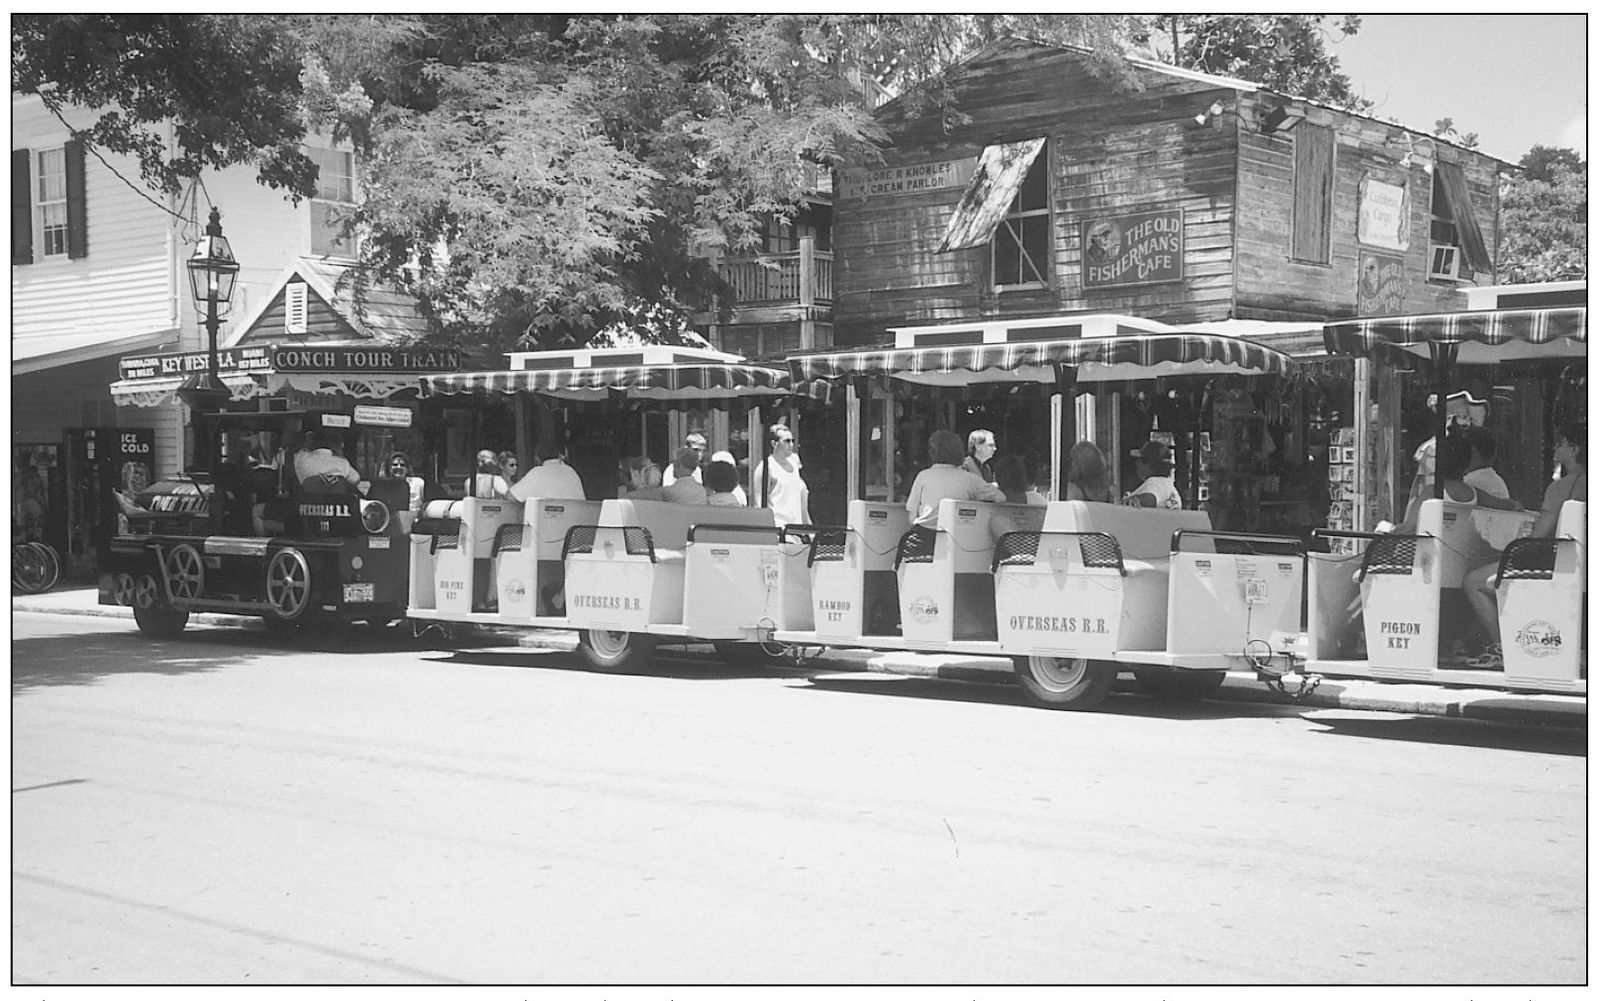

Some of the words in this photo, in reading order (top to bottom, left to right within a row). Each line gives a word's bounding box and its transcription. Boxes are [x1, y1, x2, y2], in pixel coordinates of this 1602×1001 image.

[905, 162, 951, 178] KNOWLES
[870, 181, 904, 195] CREAM
[906, 176, 944, 191] PARLOR
[1125, 219, 1153, 246] THE
[1154, 217, 1180, 233] OLD
[1088, 232, 1180, 281] FISHERMAN'S
[1138, 255, 1172, 279] CAFE
[161, 356, 183, 373] KEY
[184, 353, 210, 371] WEST
[216, 351, 237, 368] LA.
[250, 357, 270, 368] MILES
[275, 351, 336, 368] CONCH
[343, 351, 394, 368] TOUR
[400, 352, 458, 369] TRAIN
[121, 433, 137, 443] ICE
[121, 443, 150, 453] COLD
[299, 504, 335, 517] OVERSEAS
[450, 581, 464, 591] PINE
[446, 591, 457, 600] KEY
[574, 594, 621, 610] OVERSEAS
[624, 597, 644, 612] R.R.
[819, 600, 851, 611] RAMROD
[827, 611, 843, 623] KEY
[1009, 615, 1077, 633] OVERSEAS
[1081, 617, 1110, 635] R.R.
[1380, 622, 1421, 636] PIGEON
[1387, 636, 1411, 650] KEY
